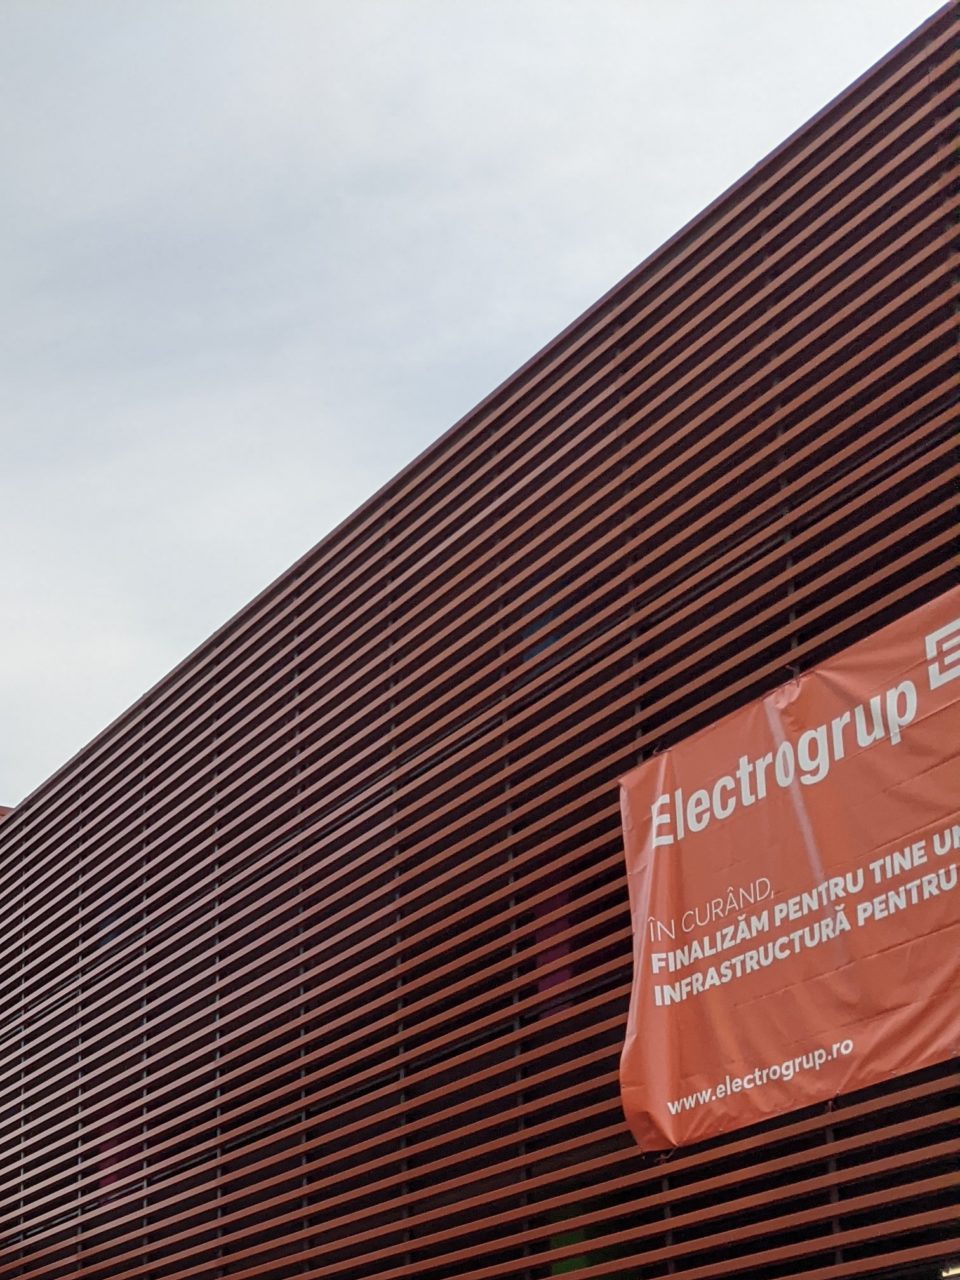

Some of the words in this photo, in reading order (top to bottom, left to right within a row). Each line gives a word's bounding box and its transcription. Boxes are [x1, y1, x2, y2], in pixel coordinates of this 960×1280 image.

[651, 680, 918, 849] Electrogrup
[648, 917, 676, 943] ÎN
[681, 877, 775, 934] CURÂND,
[651, 911, 770, 975] FINALIZĂM
[774, 868, 865, 927] PENTRU
[869, 839, 928, 885] TINE
[654, 903, 851, 1006] INFRASTRUCTURĂ
[856, 863, 959, 926] PENTRU
[667, 1040, 854, 1116] www.electrogrup.ro
